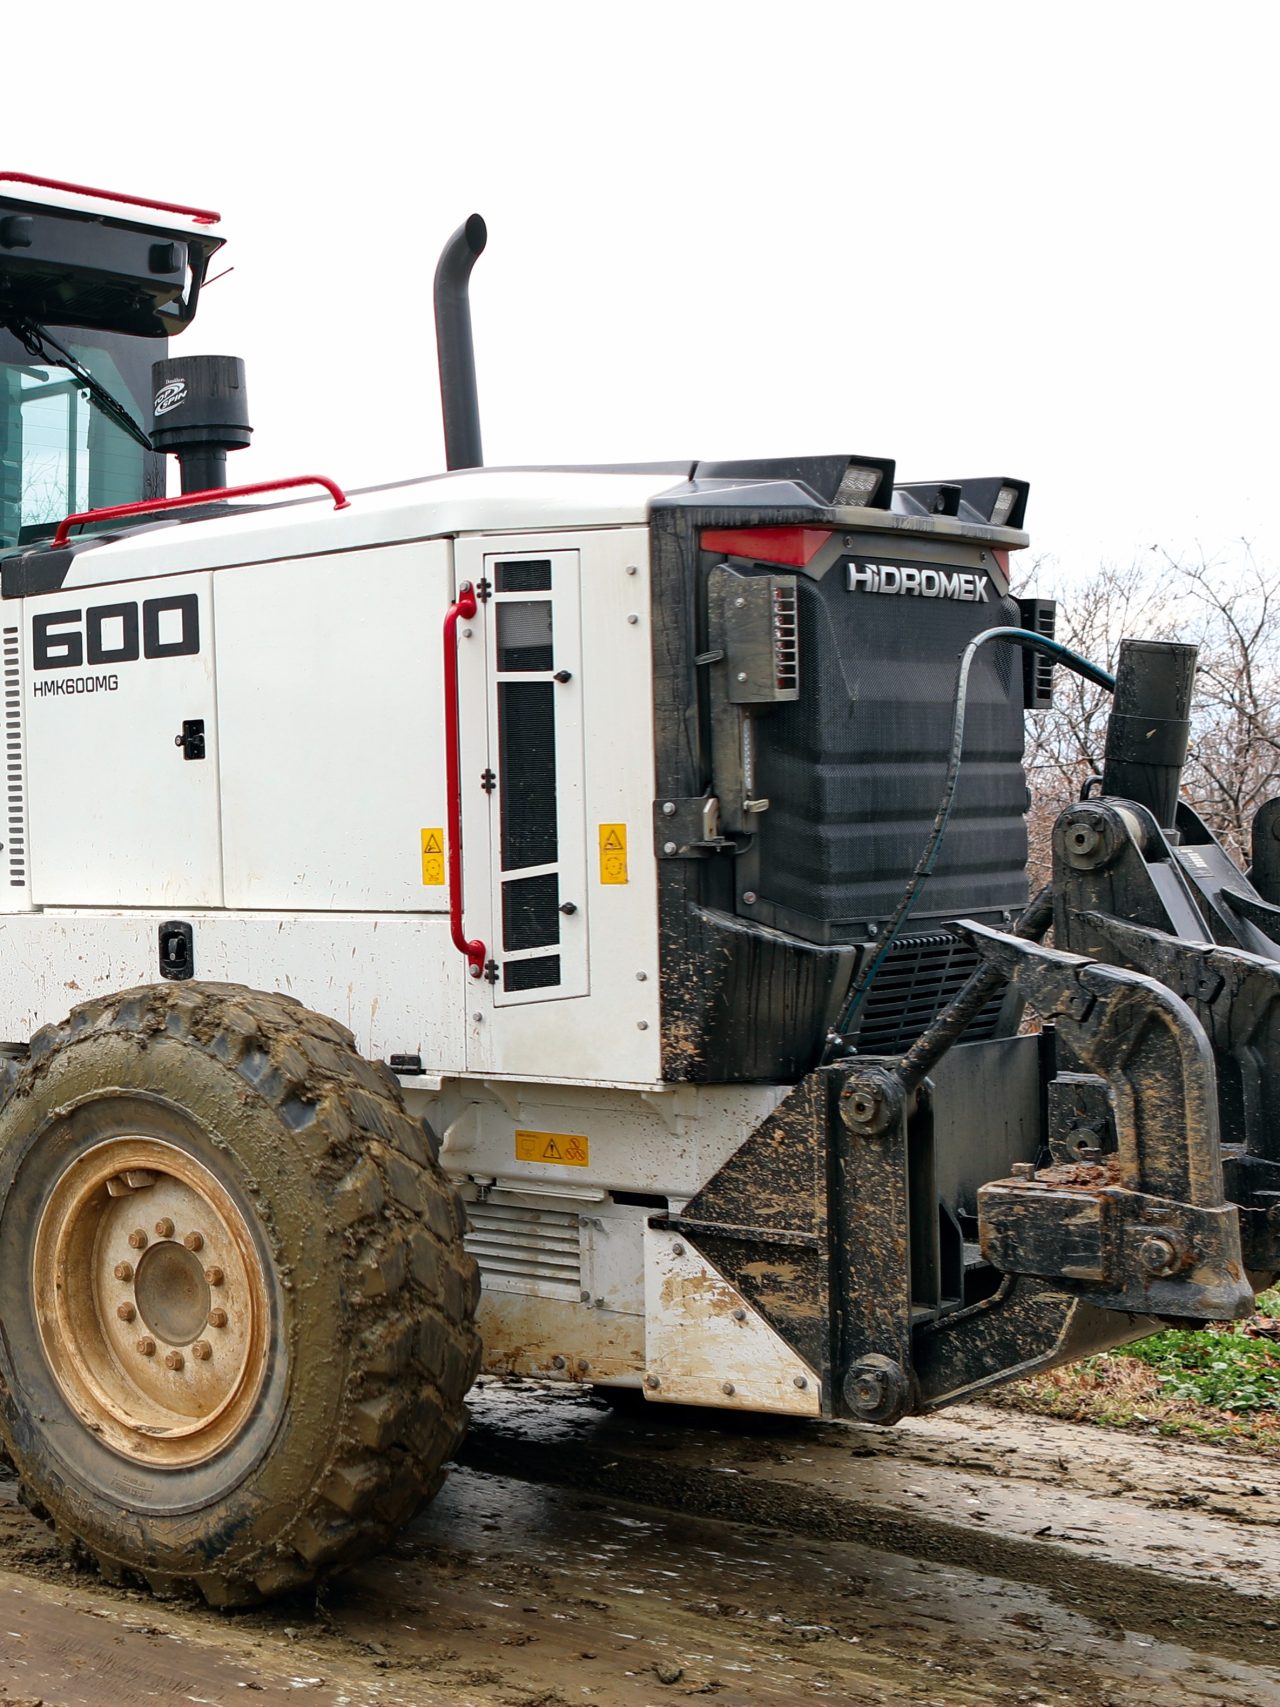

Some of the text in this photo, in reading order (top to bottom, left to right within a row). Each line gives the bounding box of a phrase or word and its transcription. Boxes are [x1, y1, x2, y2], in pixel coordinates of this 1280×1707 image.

[154, 389, 172, 407] TOP
[162, 389, 188, 409] SPIN
[32, 593, 200, 671] 600
[33, 674, 119, 698] HMK600MG
